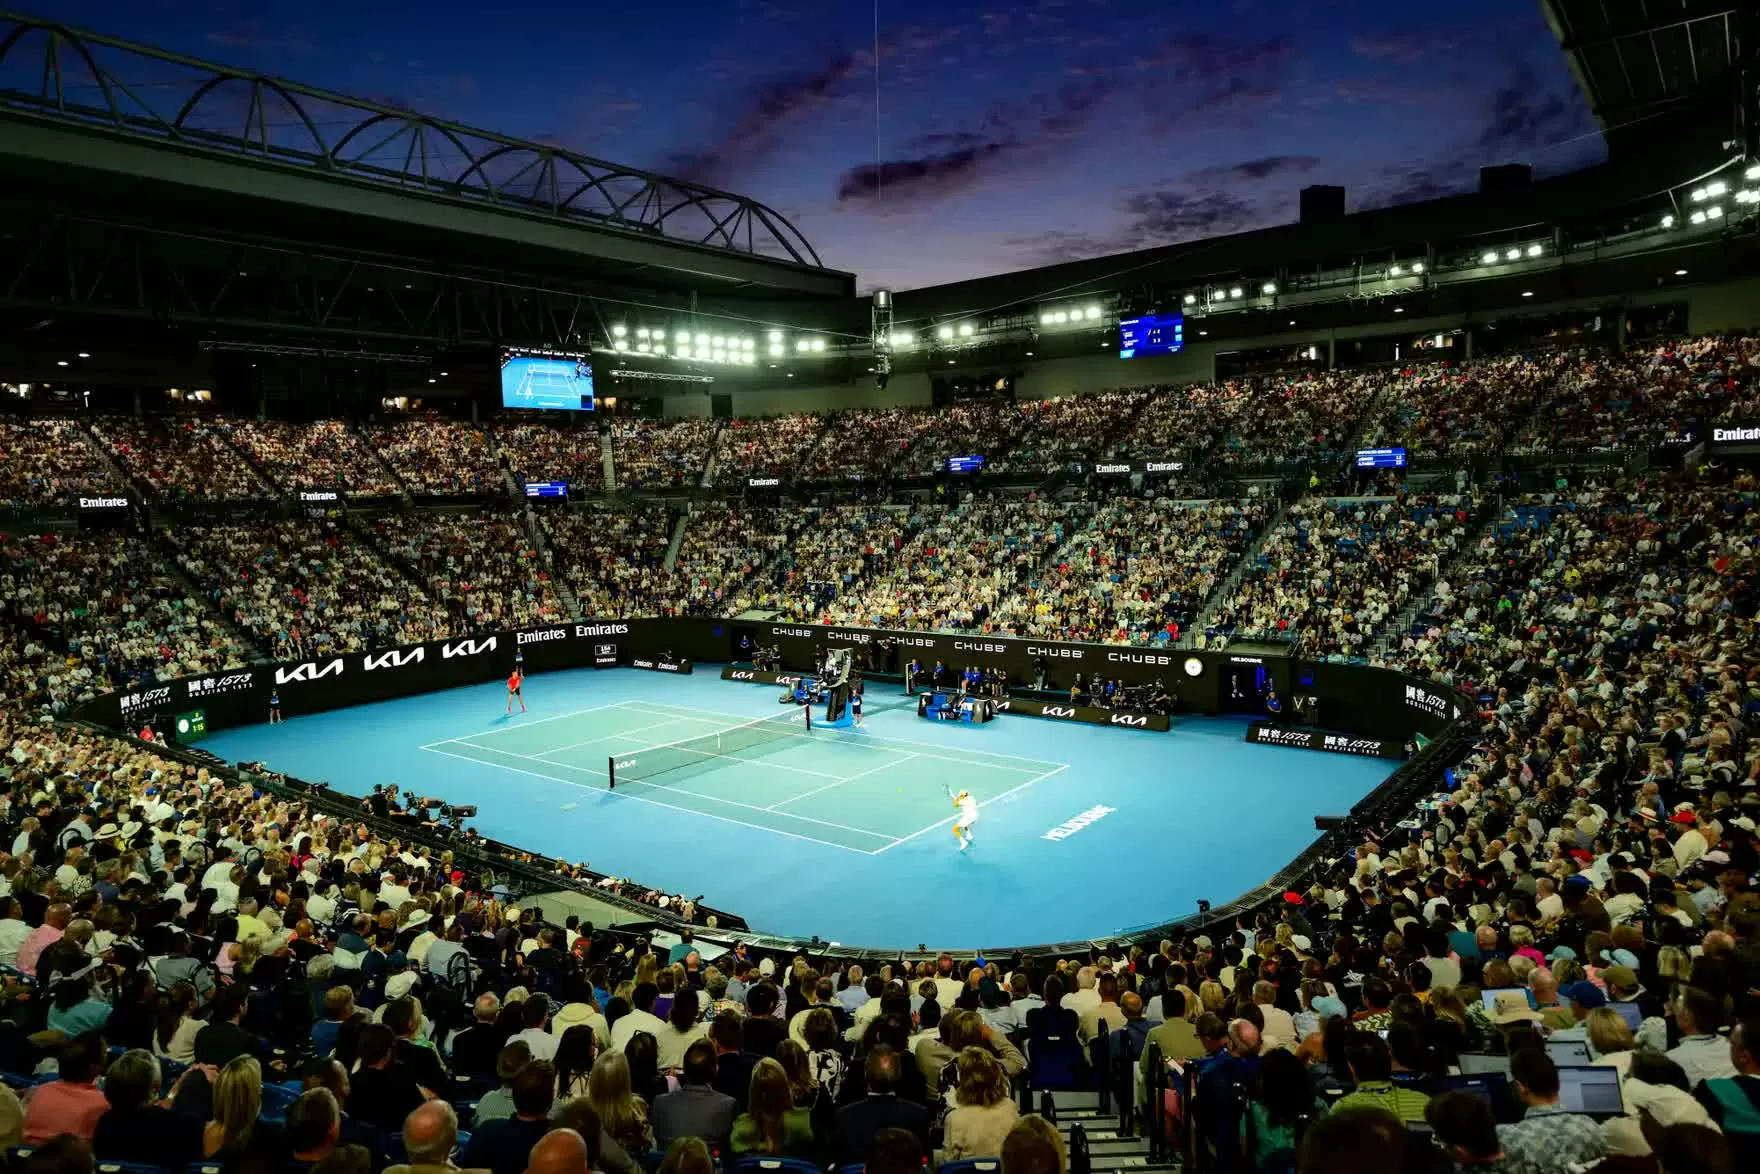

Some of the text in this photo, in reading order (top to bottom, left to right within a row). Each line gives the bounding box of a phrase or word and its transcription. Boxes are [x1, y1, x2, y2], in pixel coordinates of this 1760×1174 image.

[1713, 427, 1760, 441] Emirat
[1096, 463, 1131, 473] Emirates
[1146, 462, 1183, 472] Emirates
[749, 478, 779, 487] Emirates
[300, 491, 338, 501] Emirates
[79, 497, 128, 508] Emirates
[516, 628, 566, 644] Emirates
[576, 623, 629, 637] Emirates
[772, 627, 812, 637] CHUBB
[827, 631, 870, 641] CHUBB
[443, 636, 497, 659] KIA
[954, 641, 1006, 653] CHUBB
[1027, 647, 1085, 659] CHUBB
[363, 647, 425, 671] KIA
[1108, 652, 1172, 665] CHUBB
[275, 658, 344, 684] KIA
[731, 671, 754, 680] KIA
[1041, 705, 1076, 718] KIA
[1111, 713, 1148, 726] KIA
